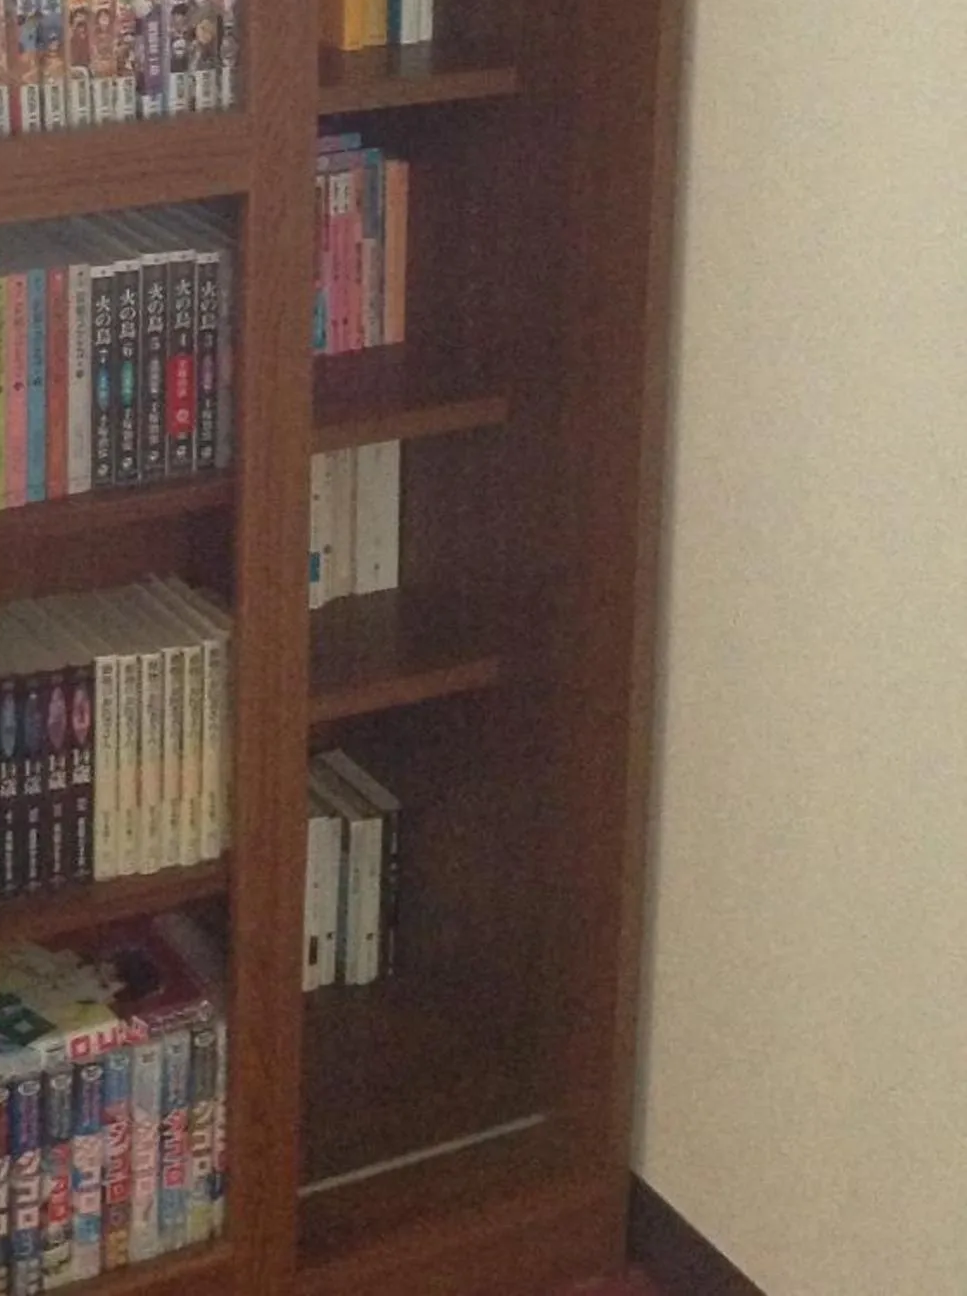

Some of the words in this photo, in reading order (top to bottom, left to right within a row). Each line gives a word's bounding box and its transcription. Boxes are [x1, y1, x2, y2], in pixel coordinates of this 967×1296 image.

[95, 294, 112, 345] 火の鳥
[119, 288, 137, 340] 火の鳥
[147, 282, 164, 333] 火の鳥
[174, 278, 192, 330] 火の鳥
[200, 280, 217, 331] 火の鳥
